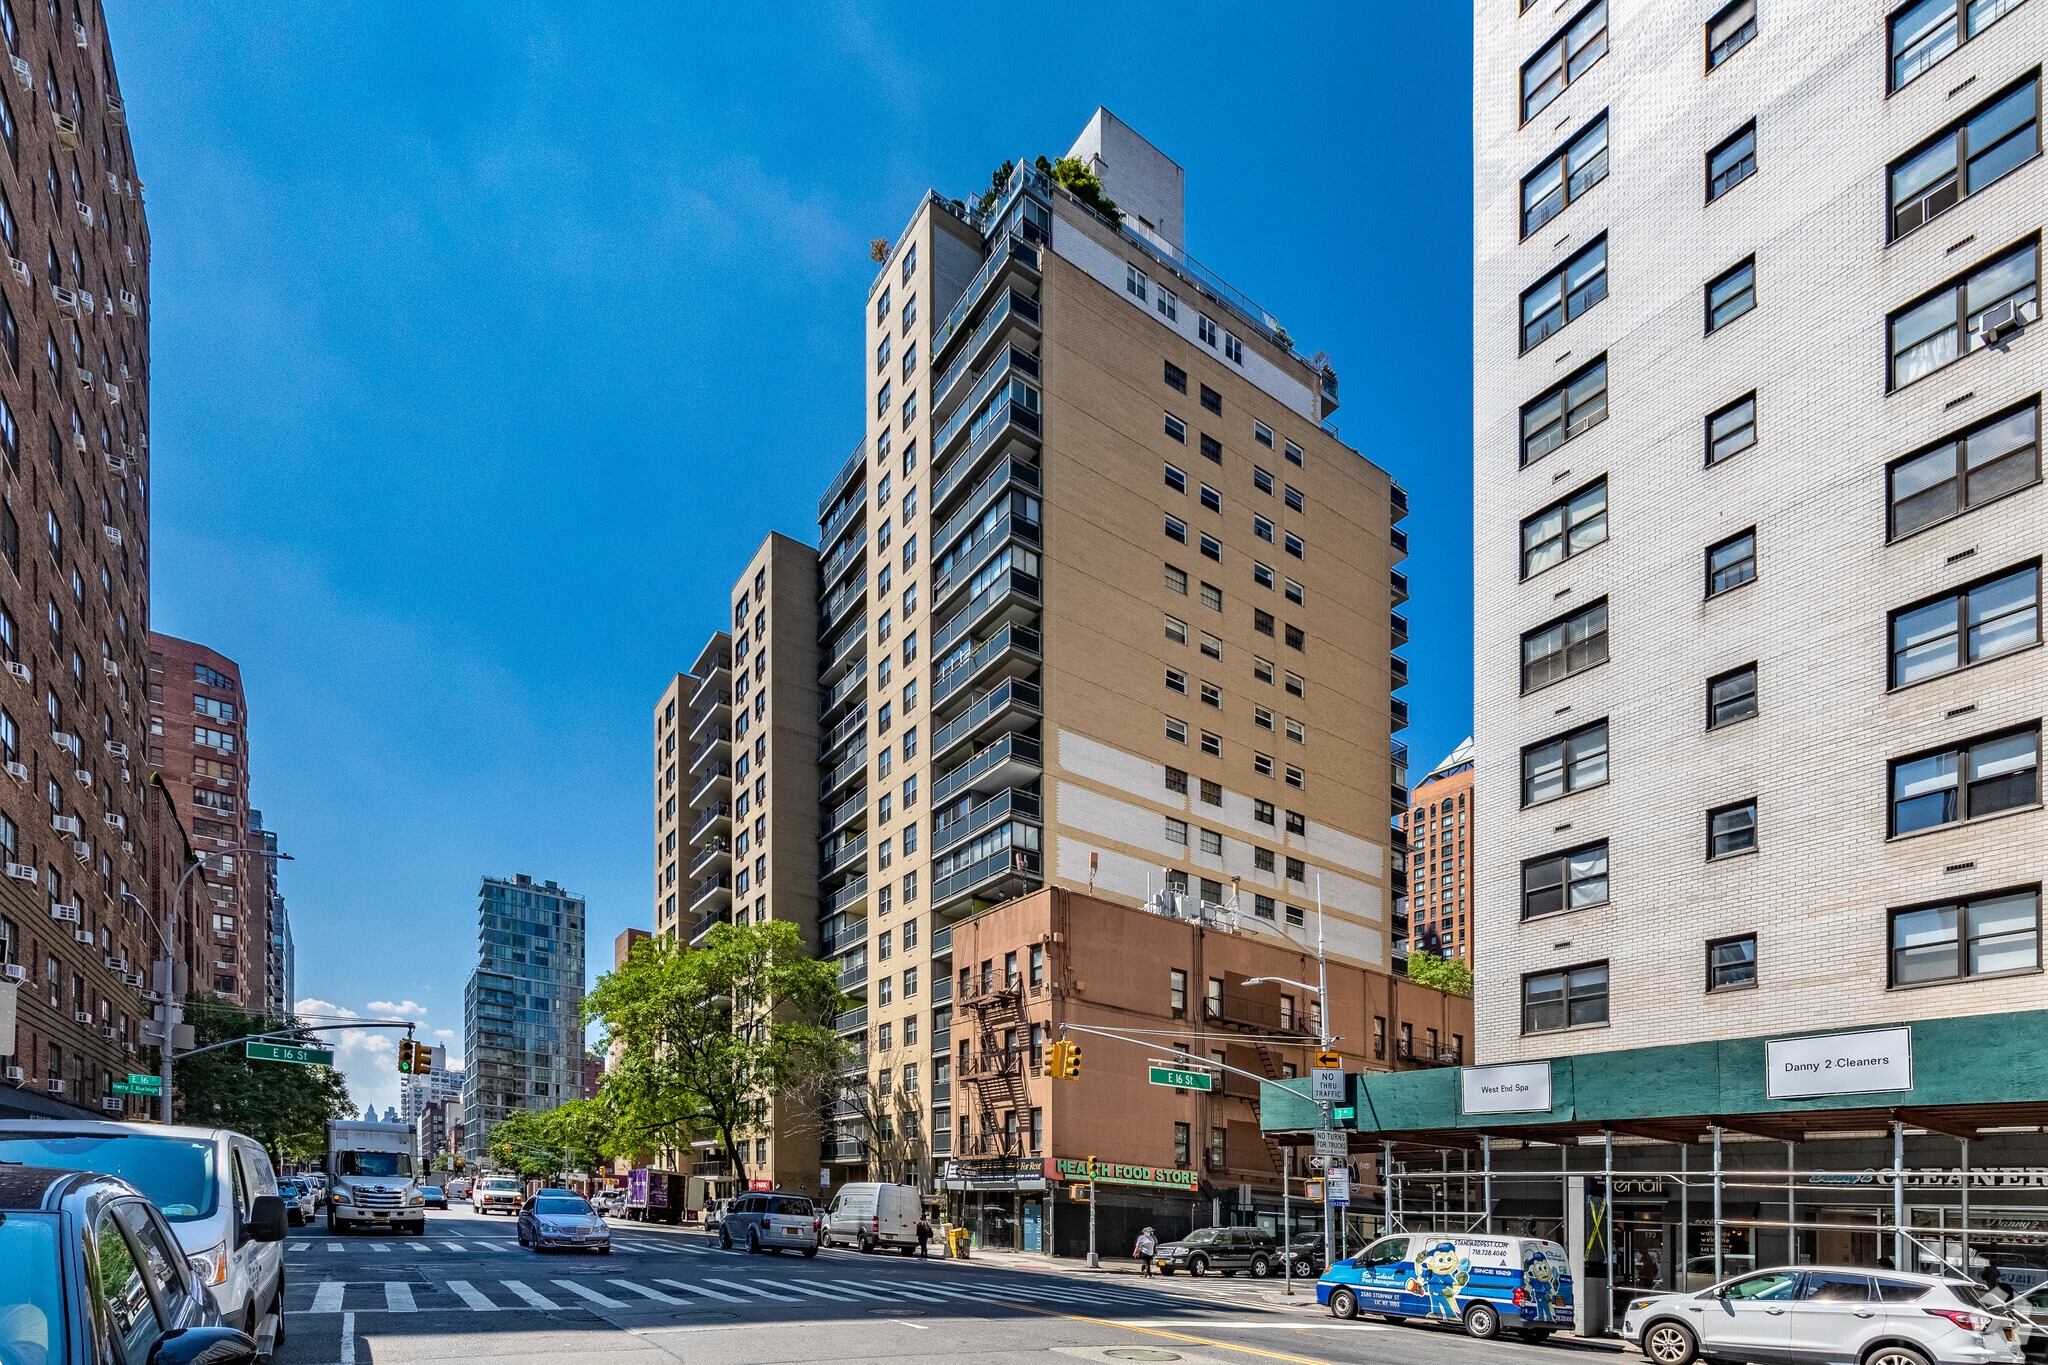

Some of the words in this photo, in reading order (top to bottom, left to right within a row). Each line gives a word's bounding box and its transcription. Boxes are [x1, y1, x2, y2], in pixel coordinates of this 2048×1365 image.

[273, 1048, 280, 1058] E
[283, 1049, 293, 1059] 16
[297, 1051, 308, 1061] St
[1785, 1062, 1820, 1073] Danny
[1824, 1059, 1832, 1069] 2
[1836, 1057, 1890, 1069] Cleaners
[1168, 1072, 1173, 1082] E
[1176, 1074, 1182, 1084] 16
[1185, 1075, 1193, 1085] St
[1515, 1084, 1528, 1092] Spa
[1317, 1132, 1325, 1140] NO
[1327, 1133, 1346, 1141] TURNS
[1020, 1163, 1029, 1171] For
[1115, 1165, 1151, 1180] FOOD
[1156, 1170, 1199, 1185] STORE
[1613, 1176, 1663, 1193] enail
[1986, 1218, 2031, 1230] Danny
[2031, 1221, 2040, 1229] 2
[1454, 1240, 1509, 1249] STANDARDPEST.COM
[1472, 1249, 1507, 1257] 718.728.4040
[1373, 1279, 1405, 1287] Management
